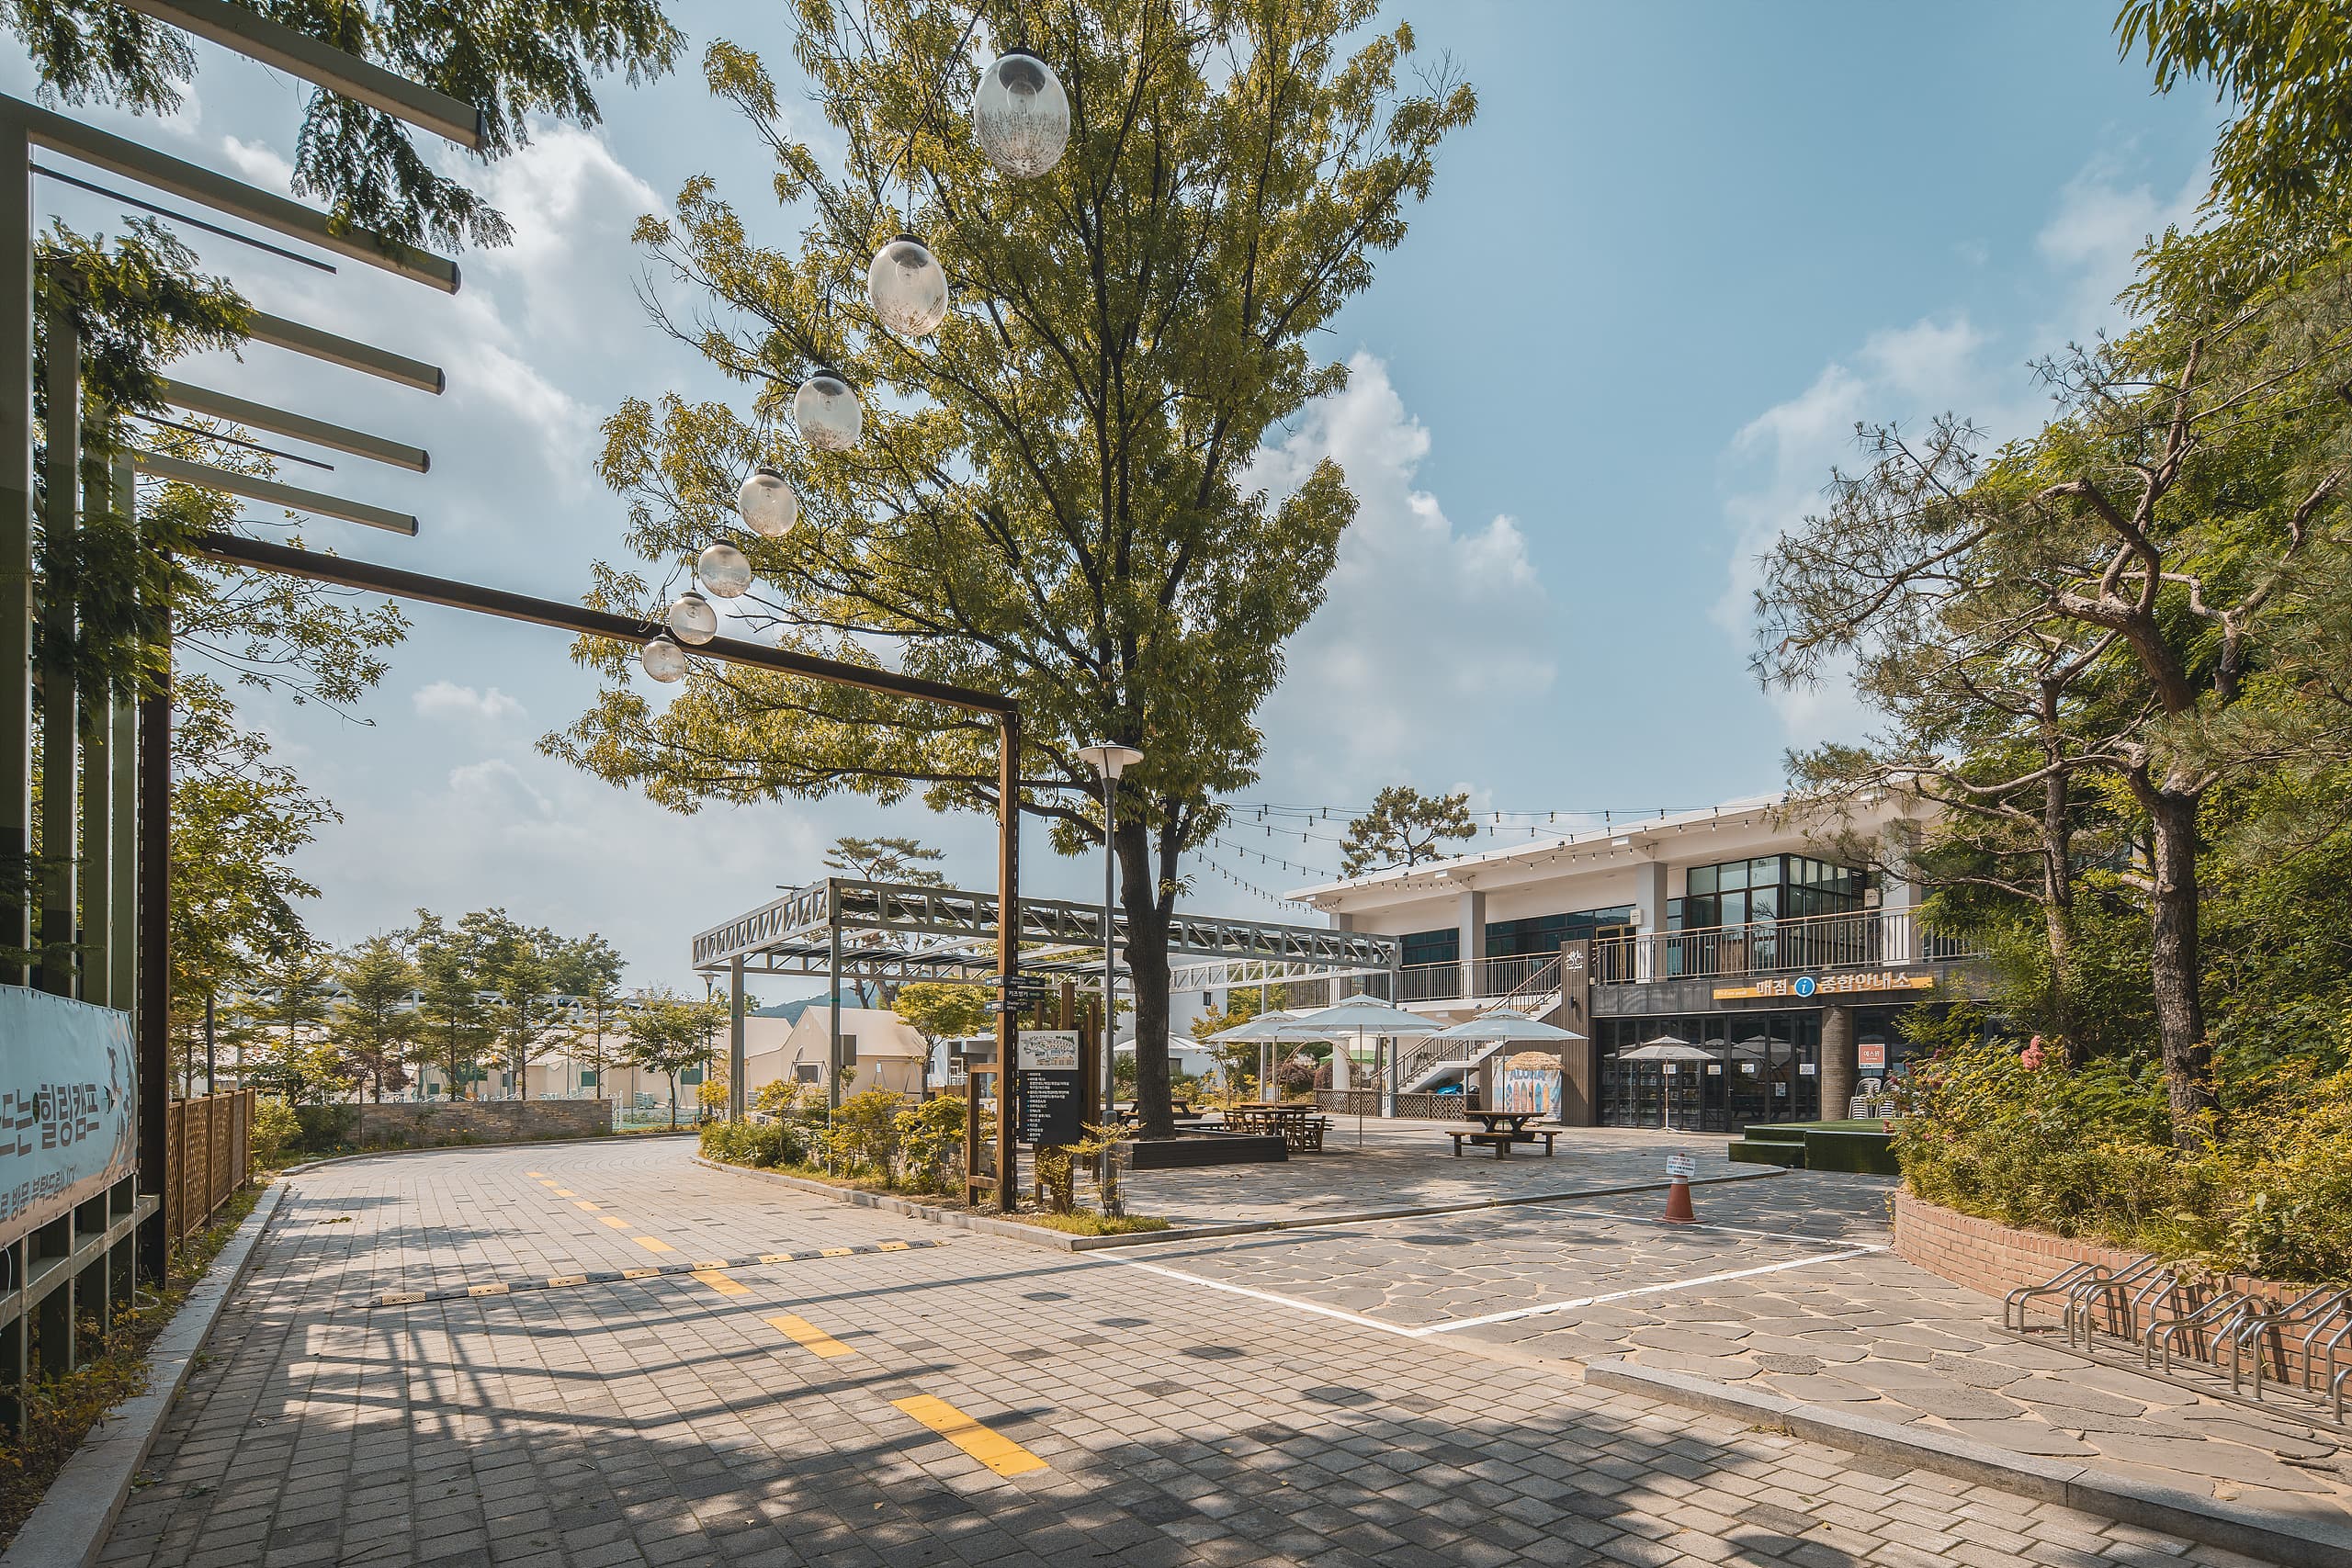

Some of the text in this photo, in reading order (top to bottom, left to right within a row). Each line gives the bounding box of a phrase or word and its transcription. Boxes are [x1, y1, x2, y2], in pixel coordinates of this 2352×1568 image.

[1757, 977, 1788, 996] 매점
[1821, 971, 1911, 993] 종합안내소
[39, 1081, 100, 1150] 힐링캠프
[11, 1181, 29, 1222] 방문
